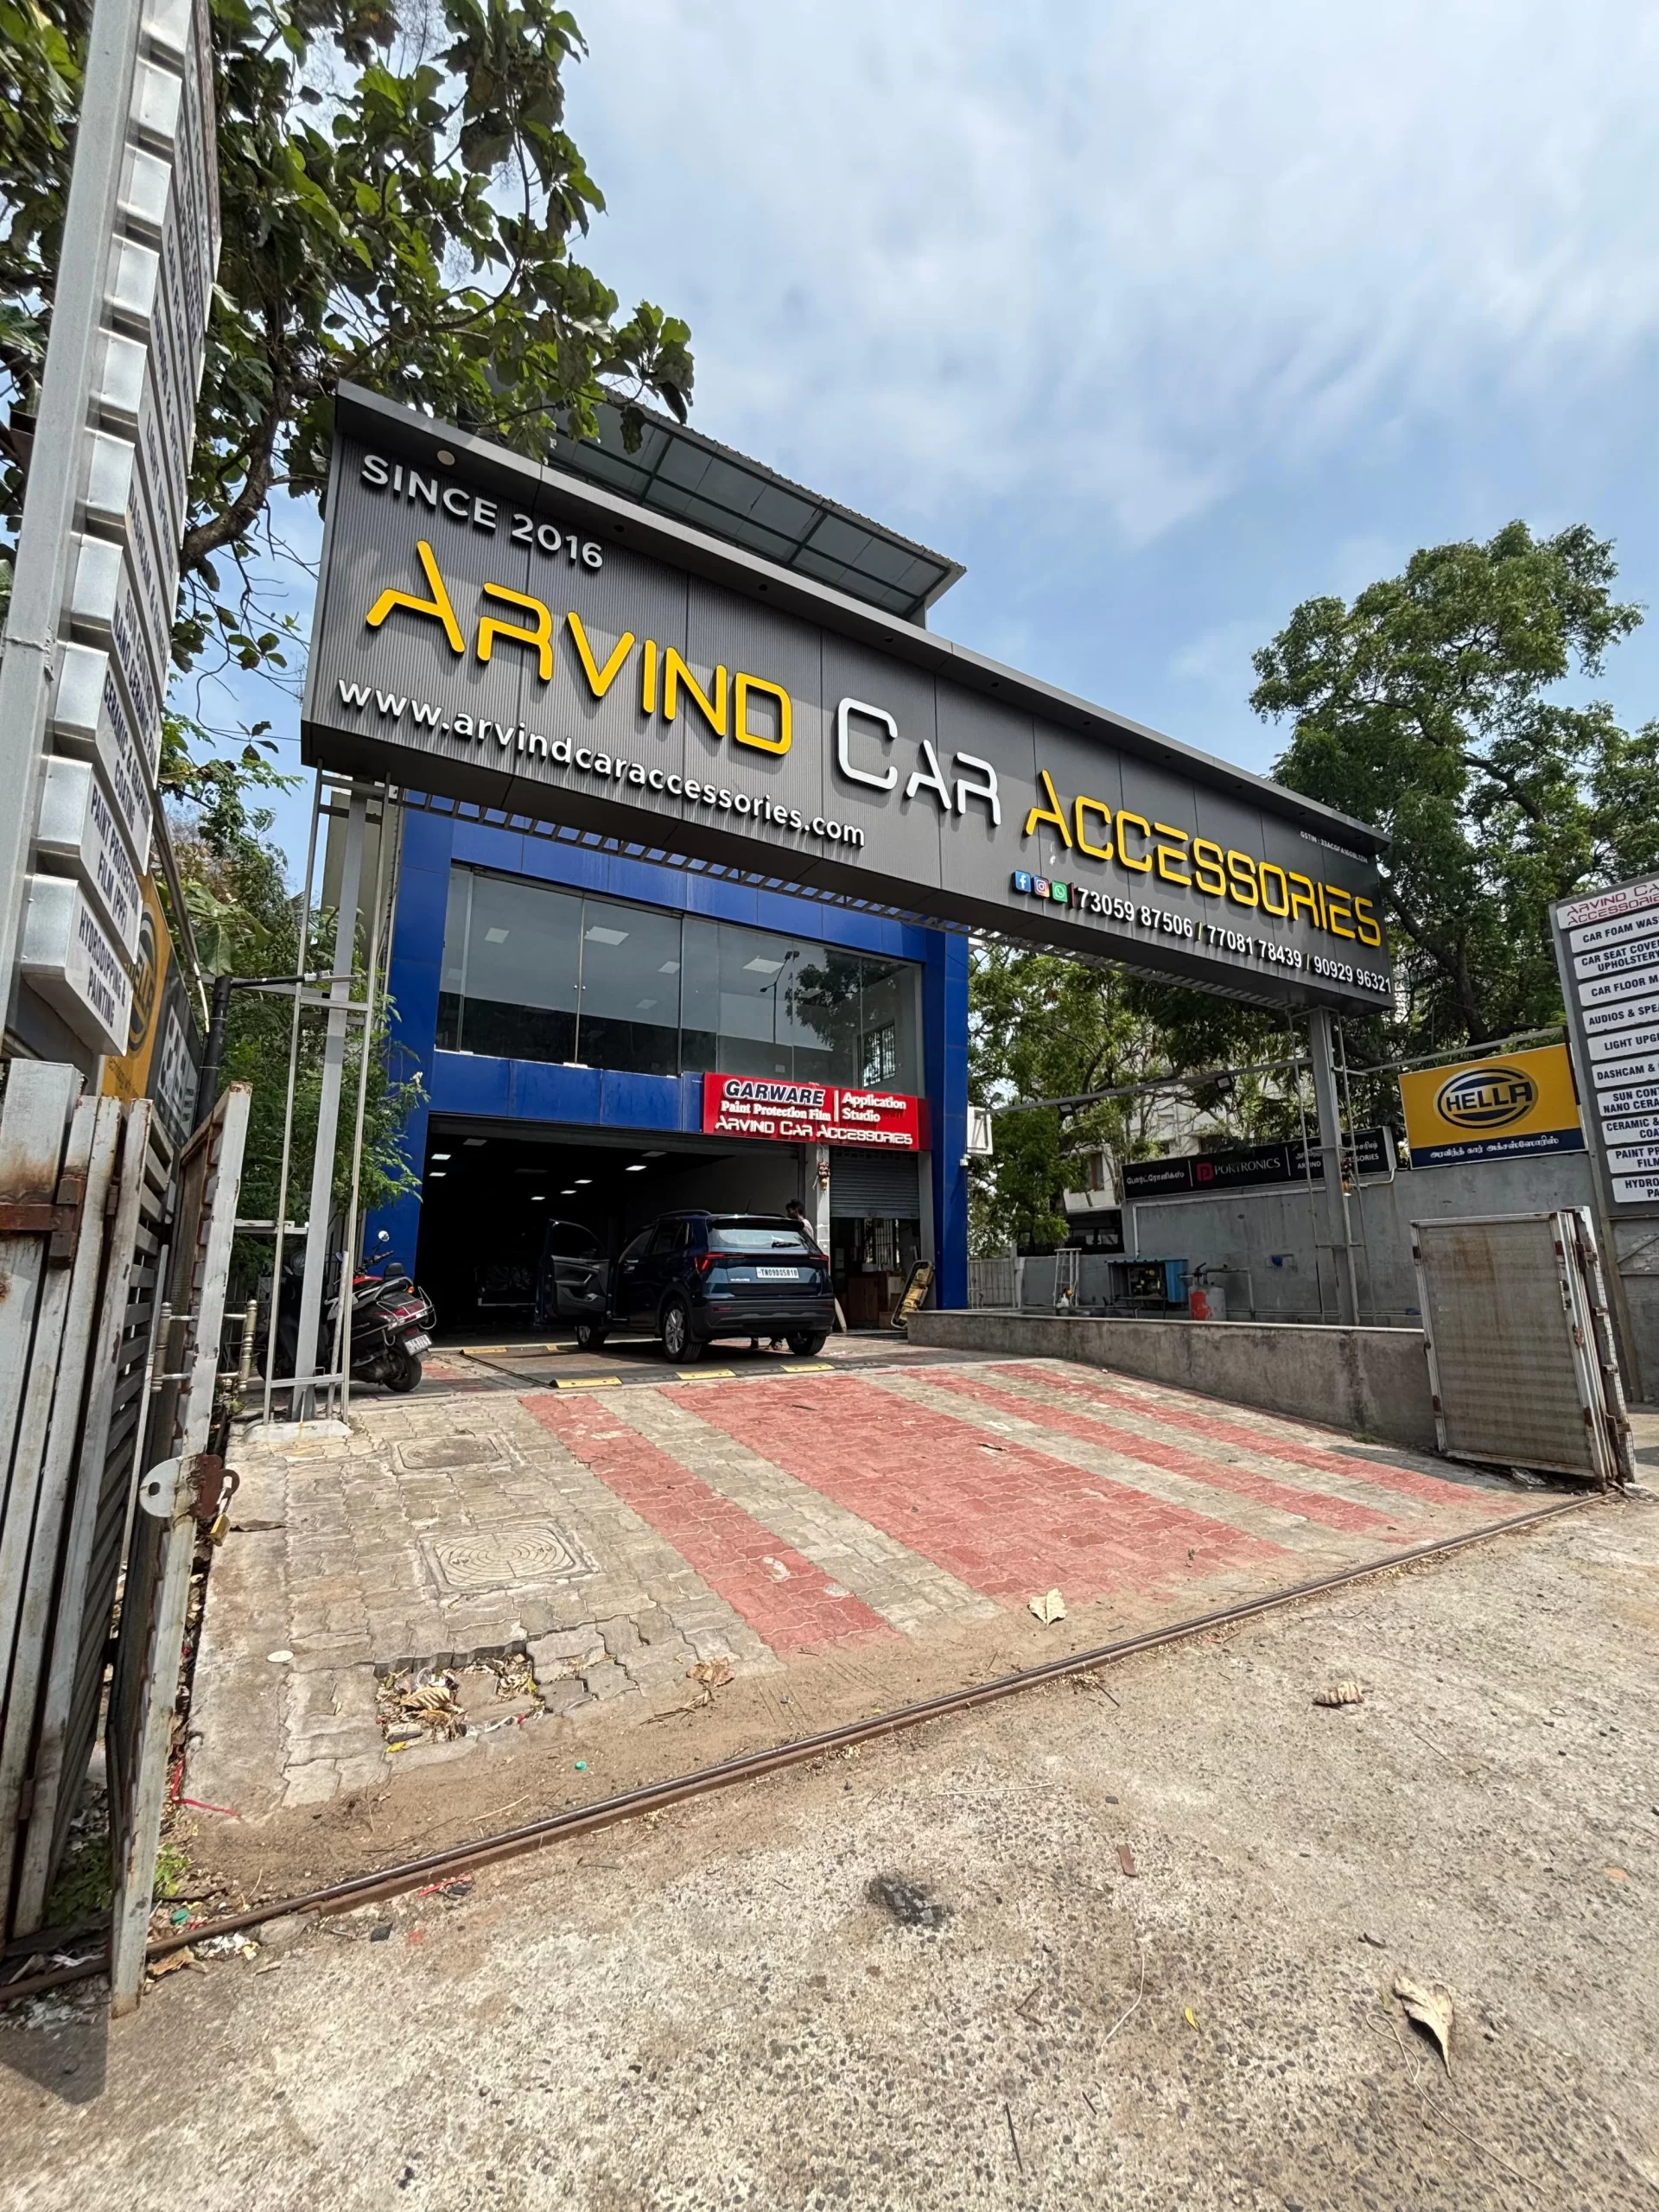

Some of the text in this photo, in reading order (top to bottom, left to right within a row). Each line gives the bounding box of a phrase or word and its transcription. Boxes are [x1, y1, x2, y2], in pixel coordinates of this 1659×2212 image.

[361, 454, 604, 570] SINCE 2016
[105, 670, 128, 760] CERAMIC
[365, 540, 1382, 947] ARVIND CAR ACCESSORIES
[337, 678, 866, 849] www.arvindcaraccessories.com
[90, 783, 111, 844] PAINT
[97, 849, 128, 936] FILM (PPF)
[1567, 892, 1627, 917] ARVIND
[1077, 887, 1392, 995] 73059 87506 77081 78439 90929 96321
[1583, 916, 1659, 944] CAR FOAM WAS
[79, 906, 123, 1000] HYDRODIPPING
[1581, 938, 1659, 967] CAR SEAT COVE
[87, 965, 115, 1028] PAINTING
[1591, 975, 1659, 997] CAR FLOOR M
[1588, 1003, 1659, 1026] AUDIOS & SPE
[1604, 1033, 1659, 1051] LIGHT UPG
[1597, 1063, 1656, 1080] DASHCAM &
[723, 1079, 825, 1107] GARWARE
[842, 1092, 906, 1110] Application
[1446, 1081, 1533, 1112] HELLA
[1612, 1090, 1633, 1102] SUN
[721, 1101, 831, 1122] Paint Protection Film
[842, 1109, 880, 1122] Studio
[1603, 1102, 1630, 1114] NANO
[715, 1116, 913, 1145] ARVIND CAR ACCESSORIES
[1606, 1118, 1649, 1131] CERAMIC
[1214, 1157, 1281, 1176] PORTRONICS
[1615, 1147, 1644, 1160] PAINT
